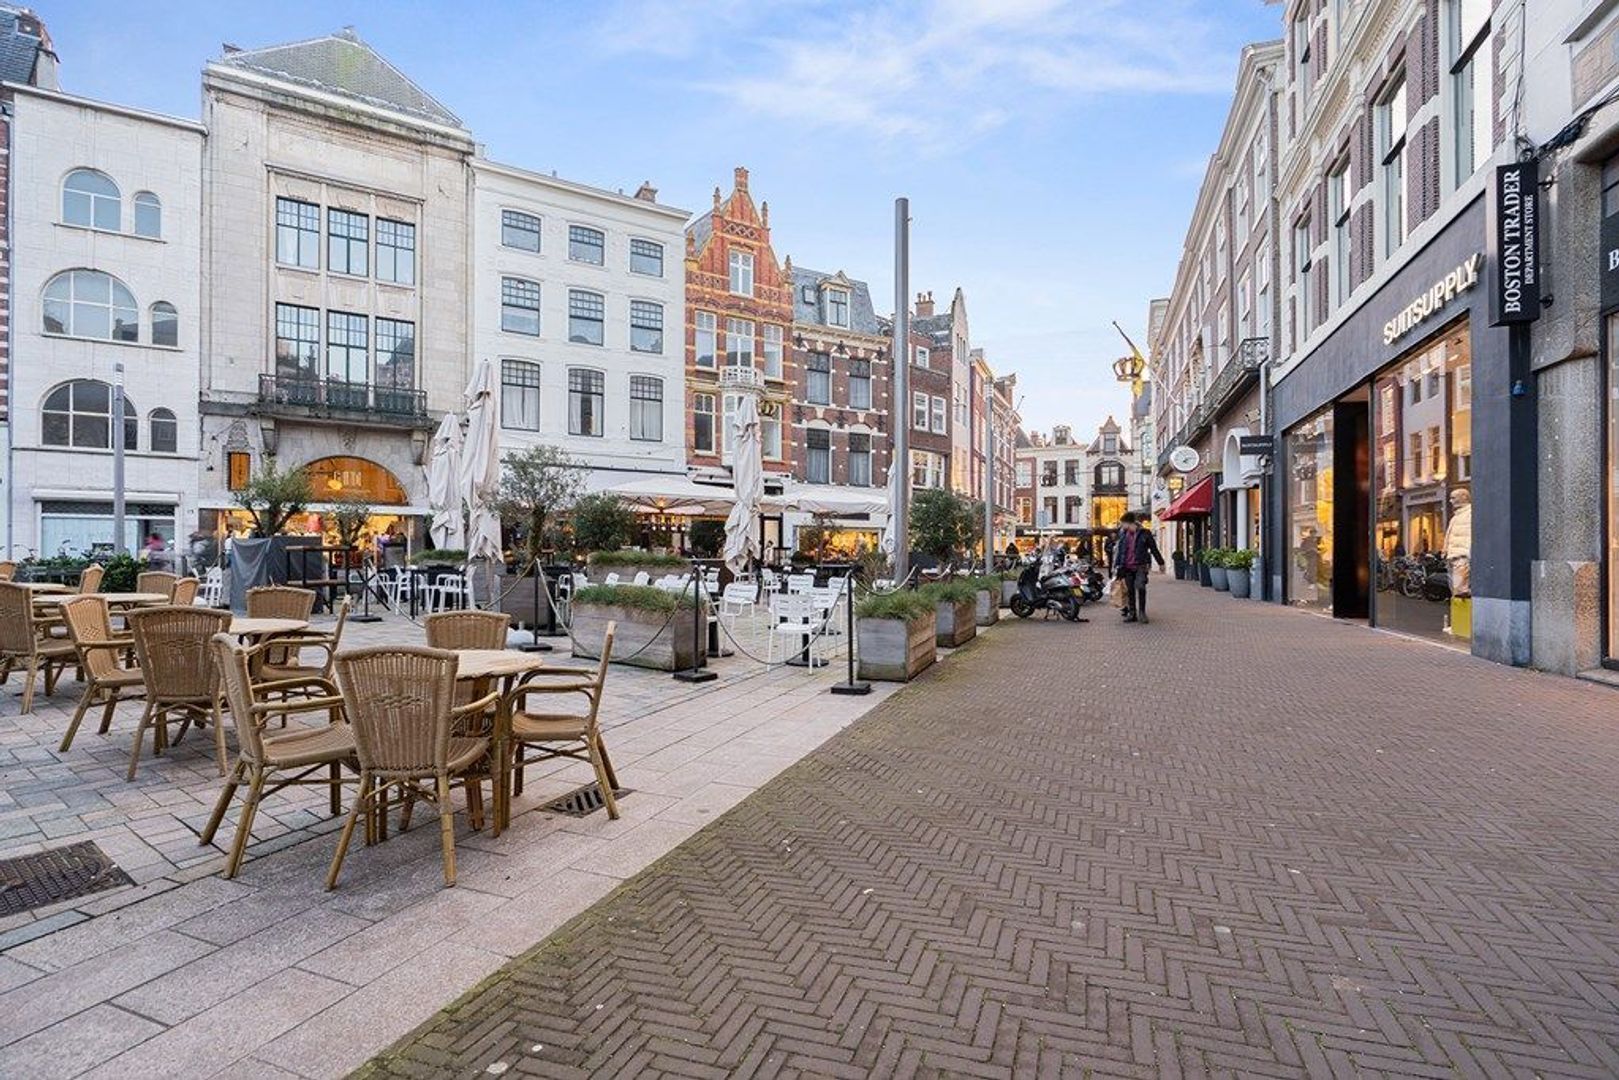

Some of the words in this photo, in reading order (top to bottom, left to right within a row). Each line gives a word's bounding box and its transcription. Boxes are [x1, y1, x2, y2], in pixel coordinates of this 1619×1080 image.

[1503, 169, 1521, 241] TRADER
[1524, 194, 1534, 224] STORE
[1503, 243, 1521, 314] BOSTON
[1525, 225, 1535, 284] DEPARTMENT
[1383, 252, 1480, 345] SUITSUPPLY
